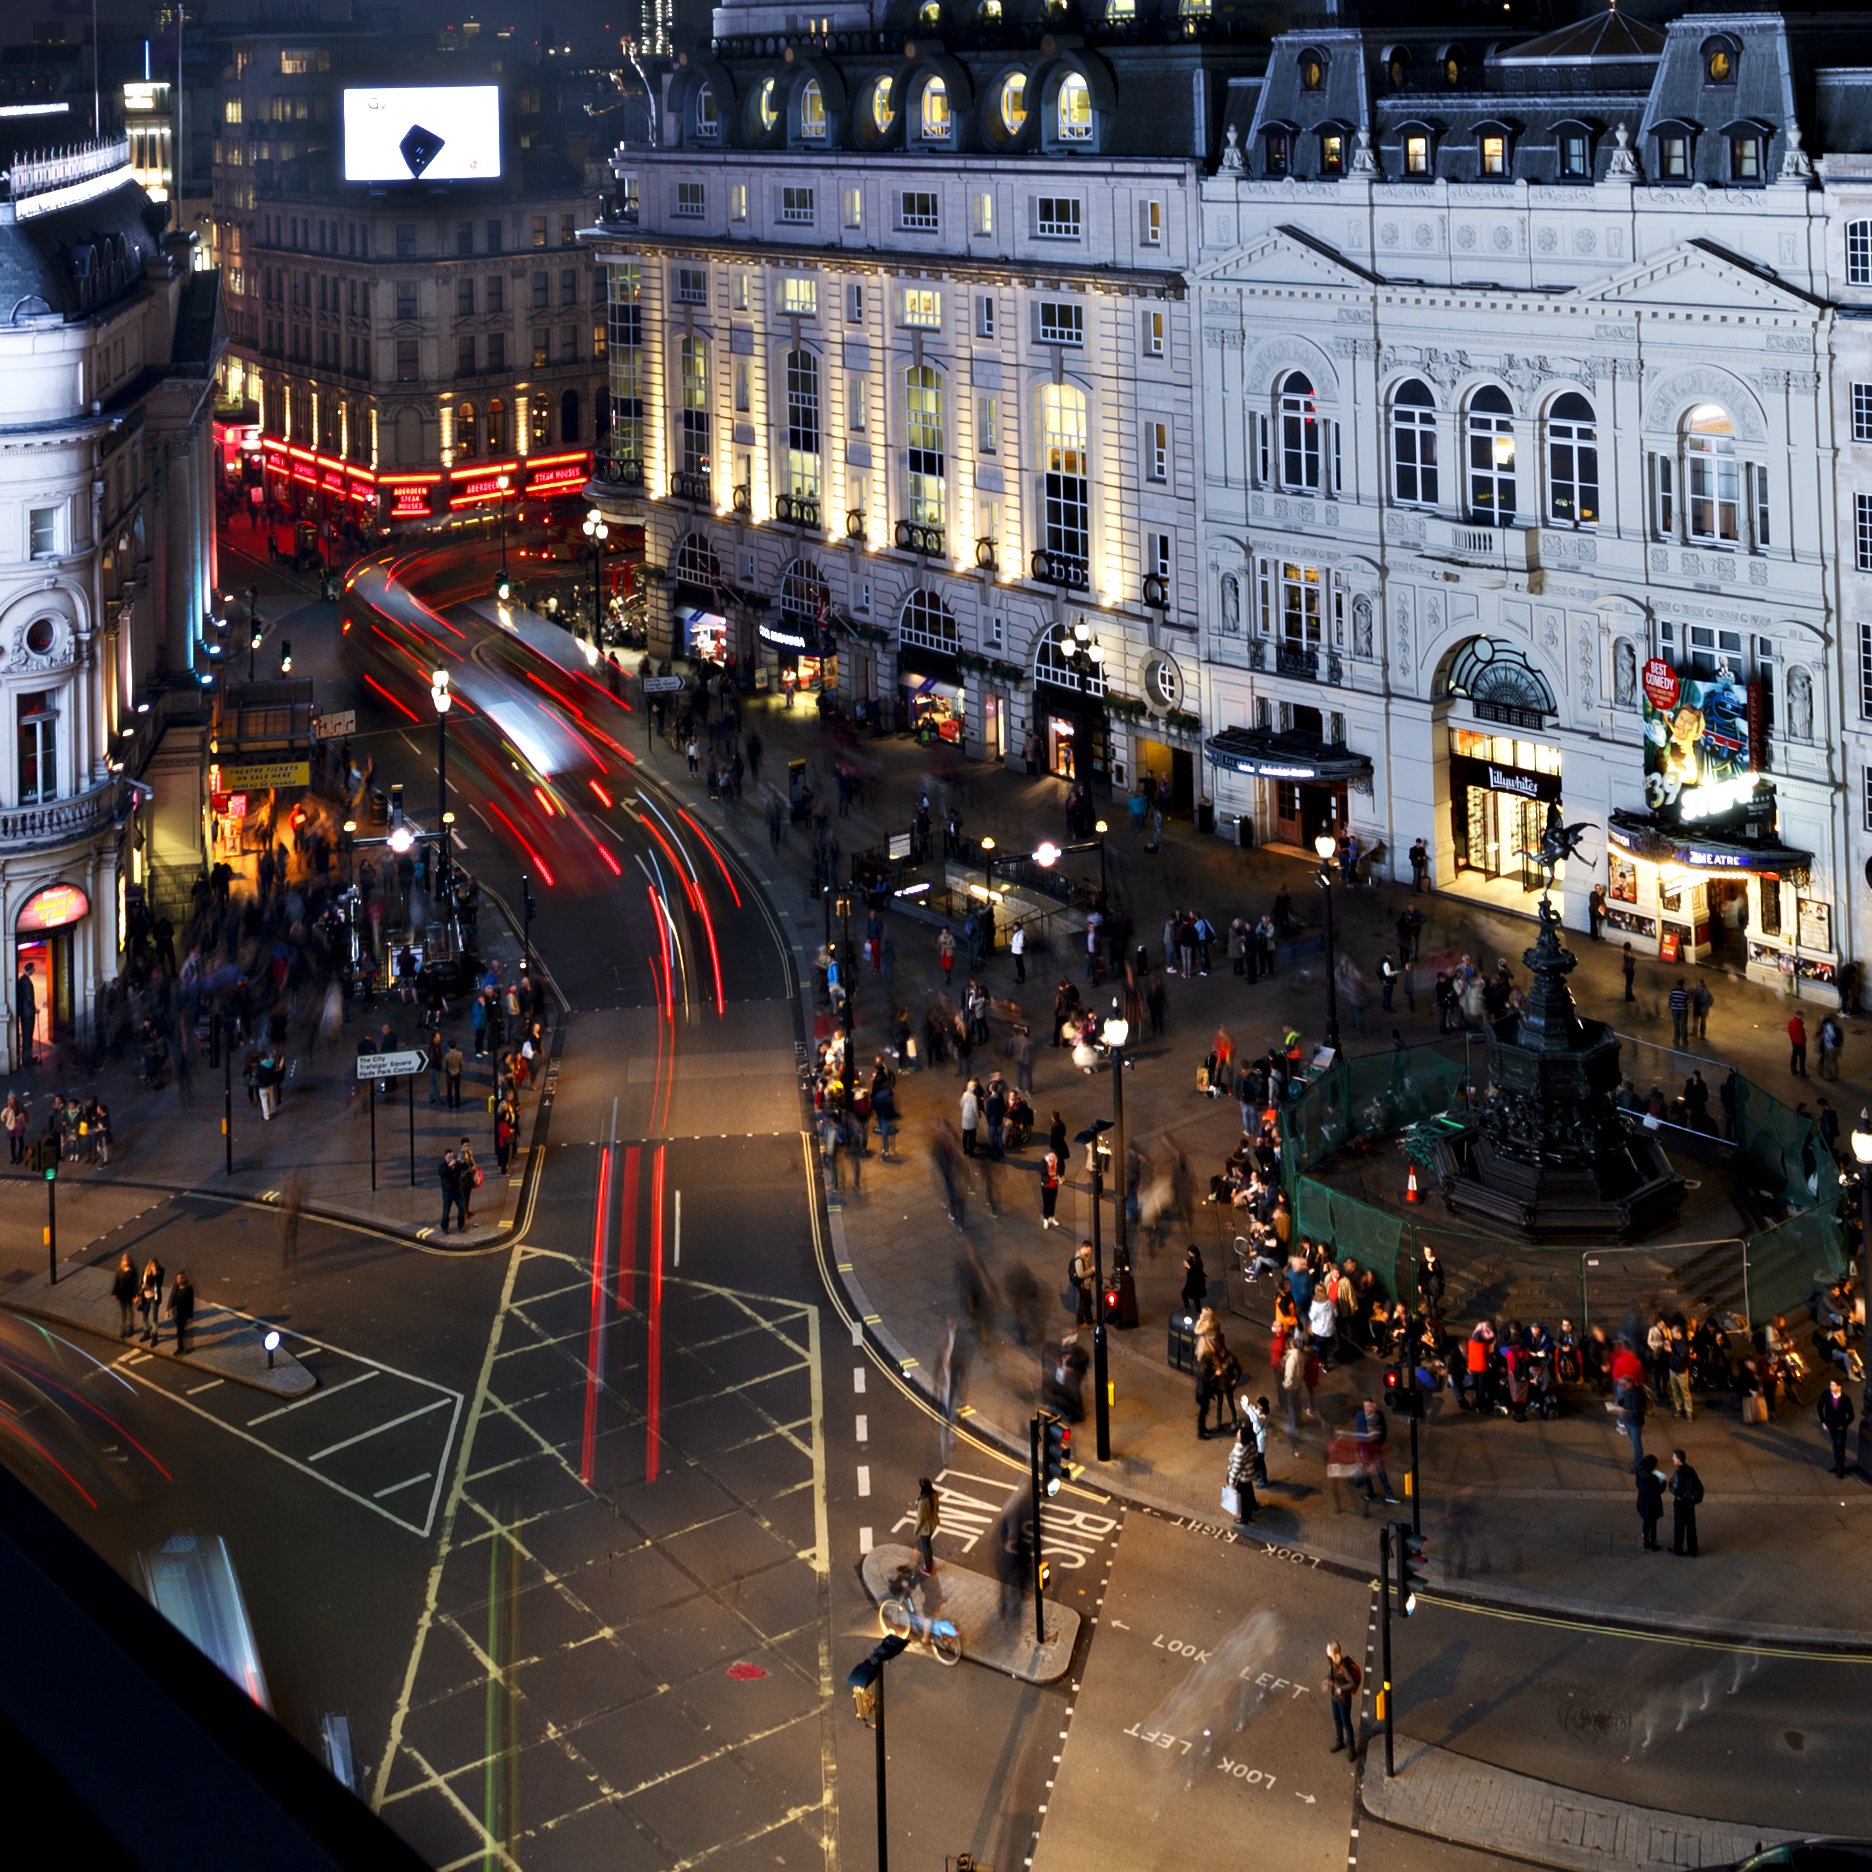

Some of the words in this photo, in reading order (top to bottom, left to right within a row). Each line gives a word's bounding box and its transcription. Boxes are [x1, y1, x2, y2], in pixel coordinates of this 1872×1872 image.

[394, 487, 427, 495] ABERDEEN
[1645, 671, 1675, 691] COMEDY
[1651, 661, 1667, 676] BEST
[1488, 766, 1538, 797] Lillywhites
[1645, 771, 1681, 809] 39
[1171, 1515, 1238, 1544] RIGHT
[1260, 1542, 1321, 1569] LOOK
[1152, 1634, 1213, 1664] LOOK
[1239, 1666, 1309, 1699] LEFT
[1123, 1722, 1193, 1755] LEFT
[1217, 1757, 1277, 1790] LOOK
